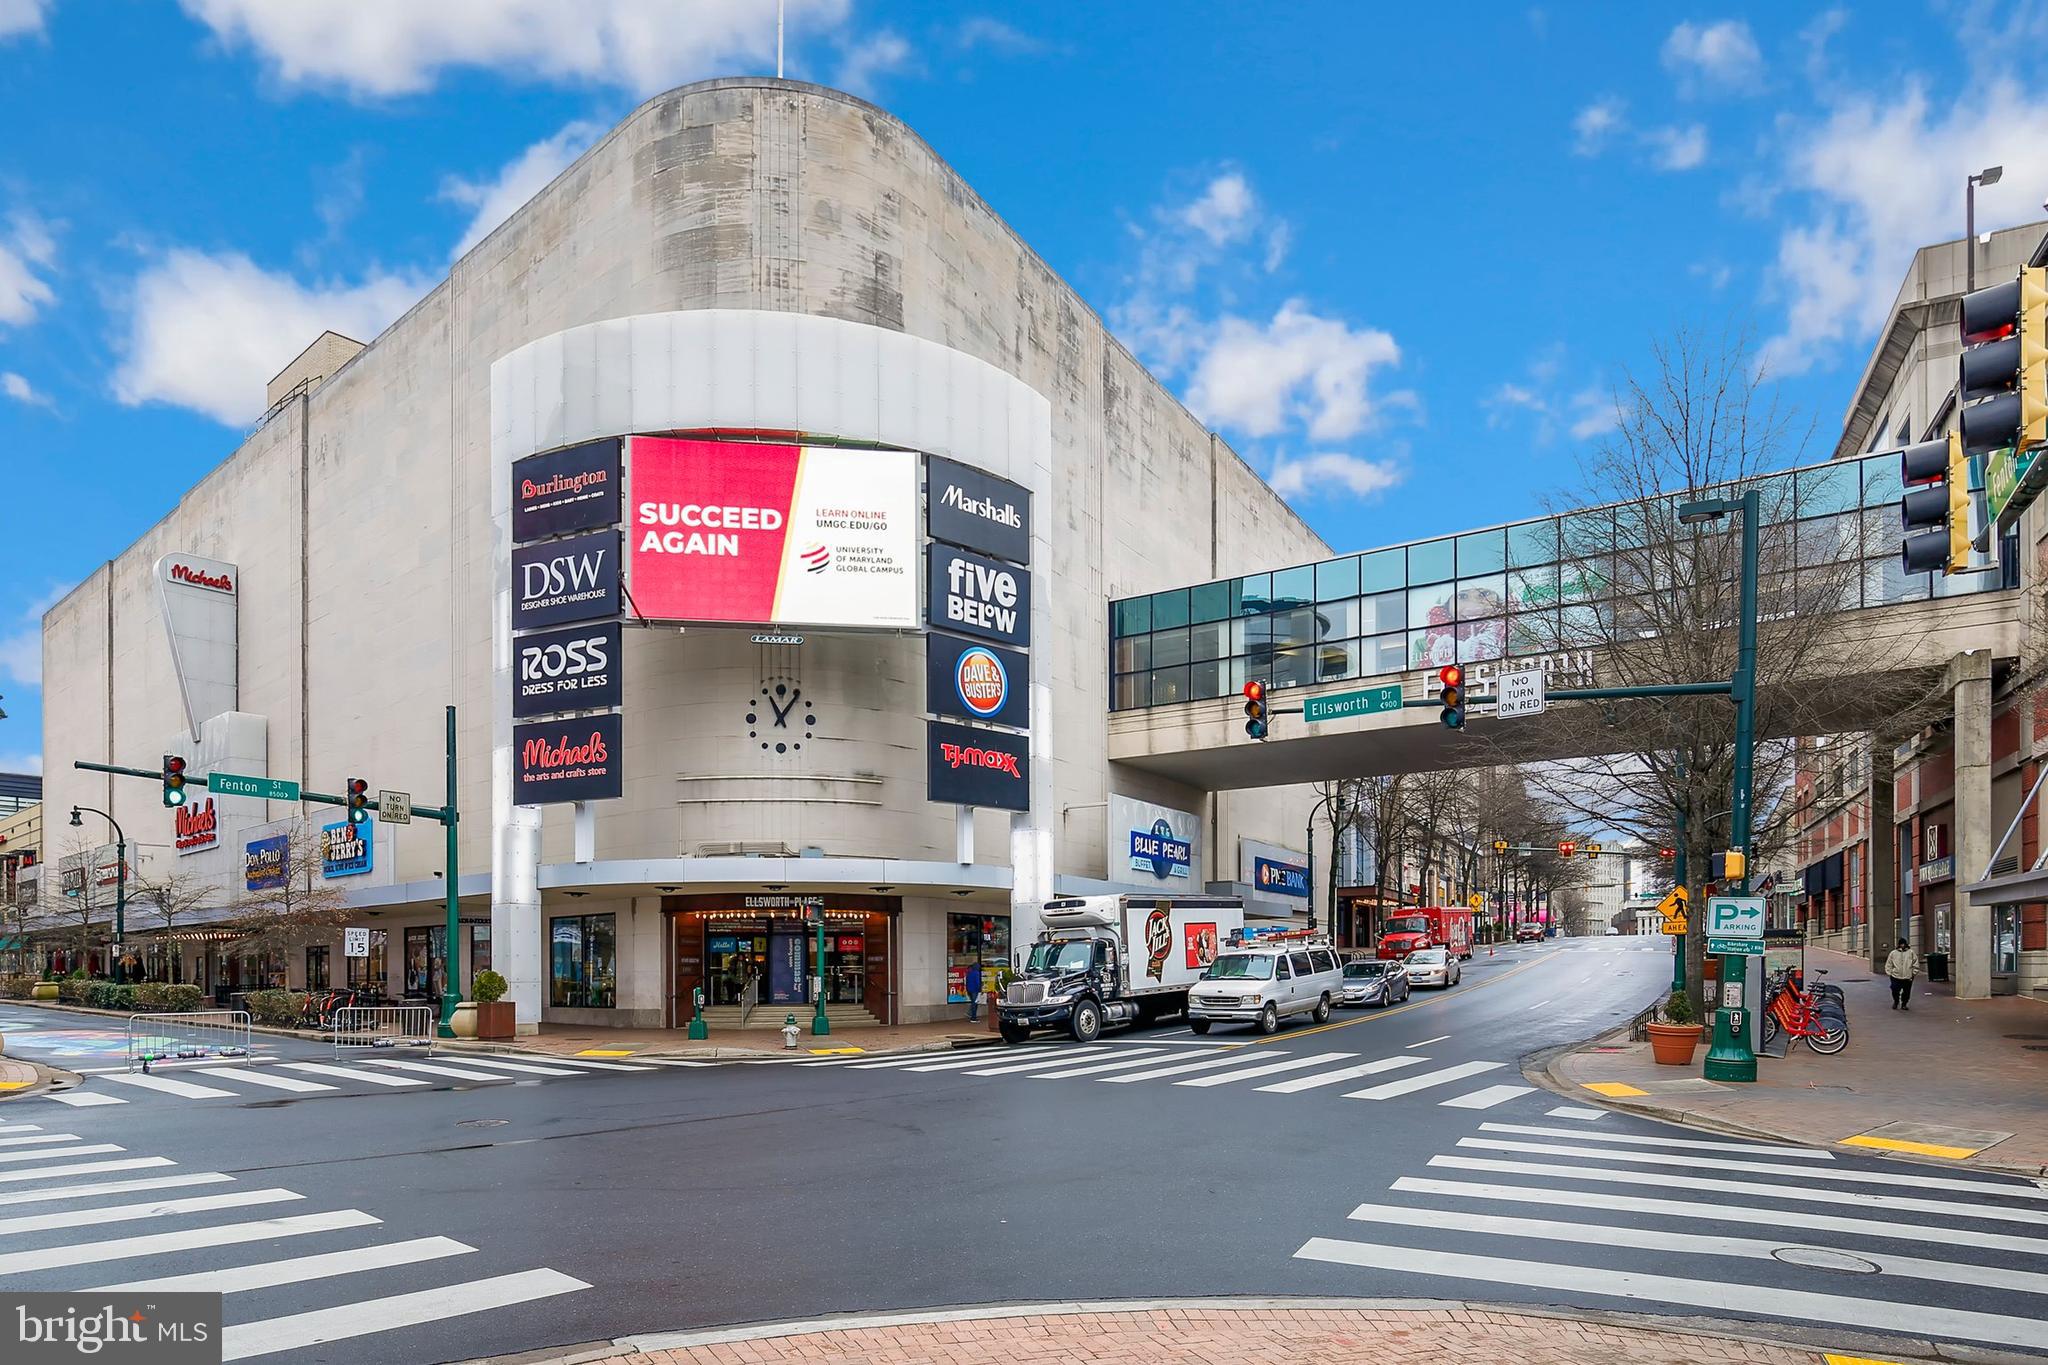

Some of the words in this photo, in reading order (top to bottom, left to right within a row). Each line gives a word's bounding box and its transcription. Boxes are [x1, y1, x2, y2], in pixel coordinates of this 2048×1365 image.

[521, 470, 608, 499] Burlington
[815, 508, 849, 518] LEARN
[850, 510, 887, 520] ONLINE
[940, 484, 1022, 529] Marshalls
[638, 502, 783, 531] SUCCEED
[816, 519, 888, 531] UMGC.EDU/GO
[639, 530, 739, 557] AGAIN
[835, 546, 884, 555] UNIVERSITY
[835, 555, 847, 563] OF
[849, 556, 893, 564] MARYLAND
[171, 564, 233, 591] Michaels
[521, 549, 606, 601] DSW
[835, 564, 868, 573] GLOBAL
[869, 566, 904, 575] CAMPUS
[947, 557, 1018, 608] five
[521, 599, 550, 611] DESIGNER
[550, 595, 568, 606] SHOE
[567, 588, 607, 602] WAREHOUSE
[947, 594, 1017, 634] BELOW
[754, 634, 799, 643] LAMAR
[522, 636, 608, 681] ROSS
[963, 664, 990, 683] DAVE
[991, 666, 1000, 681] &
[1512, 676, 1529, 687] NO
[522, 682, 554, 696] DRESS
[557, 679, 578, 691] FOR
[581, 674, 608, 688] LESS
[964, 682, 1002, 699] BUSTER'S
[1507, 687, 1534, 699] TURN
[1381, 690, 1392, 700] Dr
[1311, 697, 1369, 716] Ellsworth
[1501, 702, 1515, 712] ON
[1519, 698, 1540, 709] RED
[522, 731, 608, 769] Michaels
[272, 780, 282, 789] St
[523, 772, 536, 783] the
[536, 771, 550, 781] arts
[550, 769, 565, 780] and
[565, 767, 586, 778] crafts
[587, 767, 607, 776] store
[220, 778, 258, 793] Fenton
[386, 803, 405, 812] TURN
[389, 795, 401, 803] NO
[175, 797, 217, 838] Michaels
[382, 811, 392, 819] ON
[394, 812, 408, 821] RED
[330, 826, 347, 845] BEN
[330, 838, 363, 861] JERRY'S
[1134, 836, 1159, 856] BLUE
[1162, 842, 1188, 861] PEARL
[1286, 870, 1305, 889] BANK
[745, 896, 790, 907] ELLSWORTH
[1146, 916, 1169, 946] JACK
[1667, 923, 1688, 931] AHEA
[350, 943, 366, 953] 15
[1149, 930, 1169, 960] JILL
